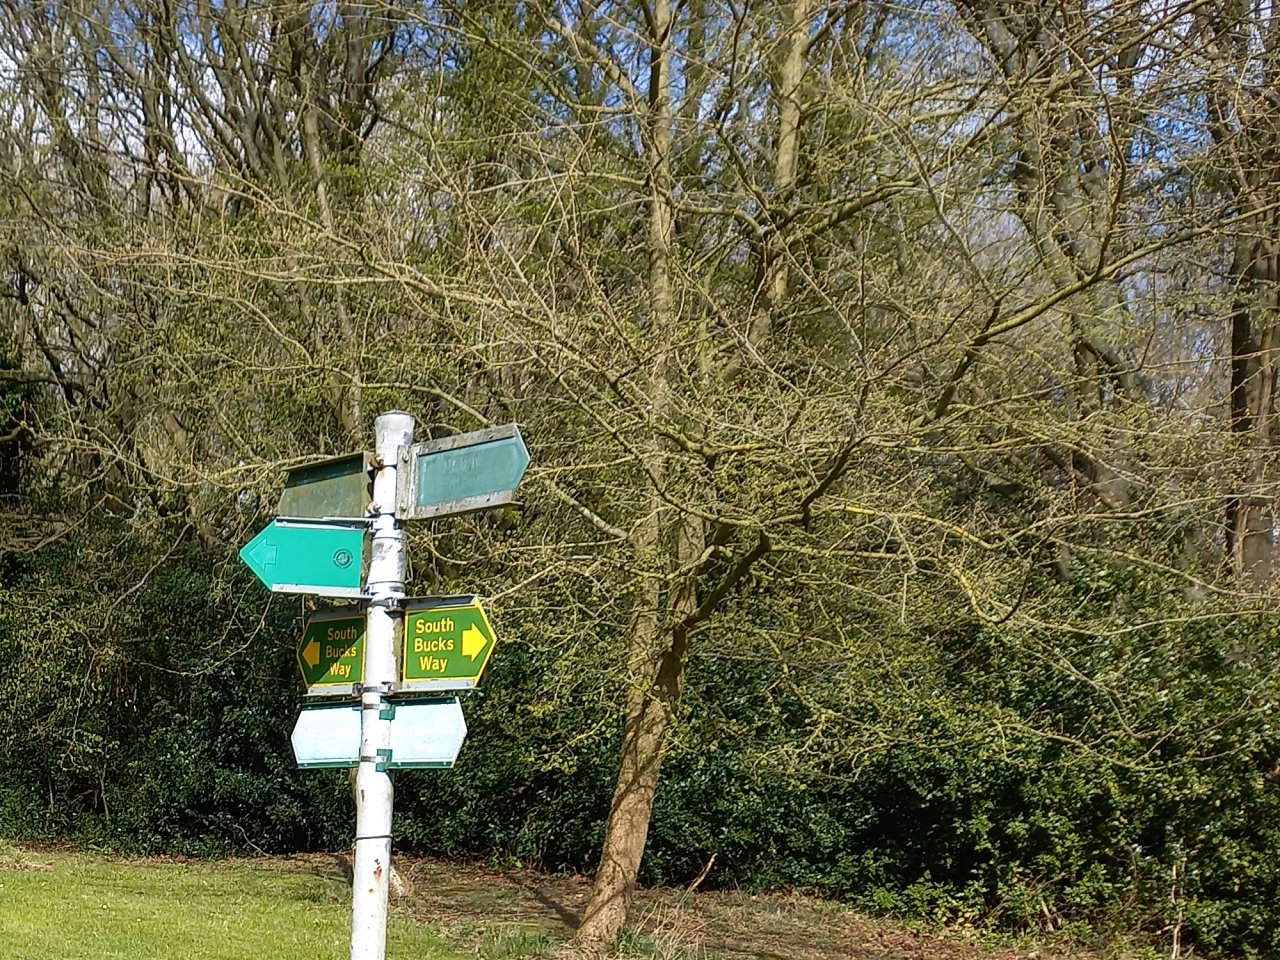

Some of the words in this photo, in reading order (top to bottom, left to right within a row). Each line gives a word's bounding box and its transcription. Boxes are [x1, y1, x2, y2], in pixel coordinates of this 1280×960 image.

[416, 618, 454, 634] South
[327, 627, 357, 641] South
[326, 645, 357, 658] Bucks
[414, 637, 455, 653] Bucks
[330, 663, 351, 678] Way
[420, 656, 448, 673] Way
